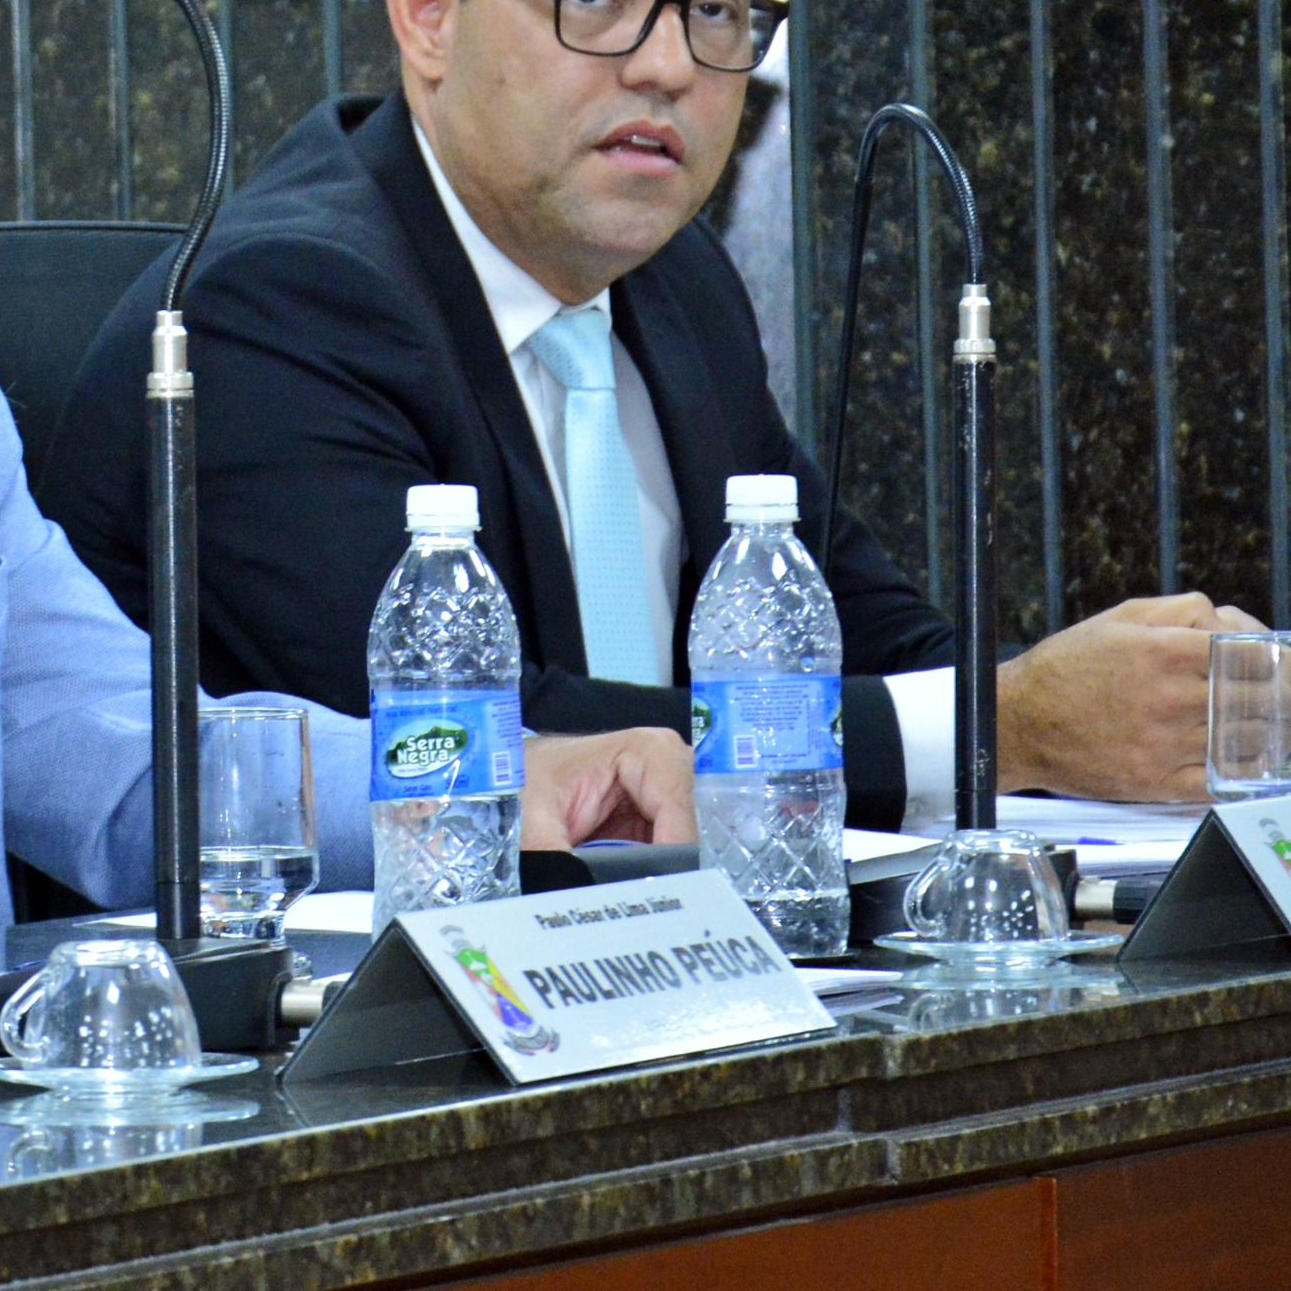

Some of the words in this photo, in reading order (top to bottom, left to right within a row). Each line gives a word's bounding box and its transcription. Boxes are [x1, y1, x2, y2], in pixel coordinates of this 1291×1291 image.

[406, 735, 456, 752] Serra
[397, 748, 450, 767] Negra
[534, 912, 573, 930] Paulo
[569, 907, 606, 925] César
[603, 904, 623, 921] de
[616, 900, 651, 918] Lima
[522, 950, 683, 1010] PAULINHO
[670, 929, 783, 985] PEÚCA
